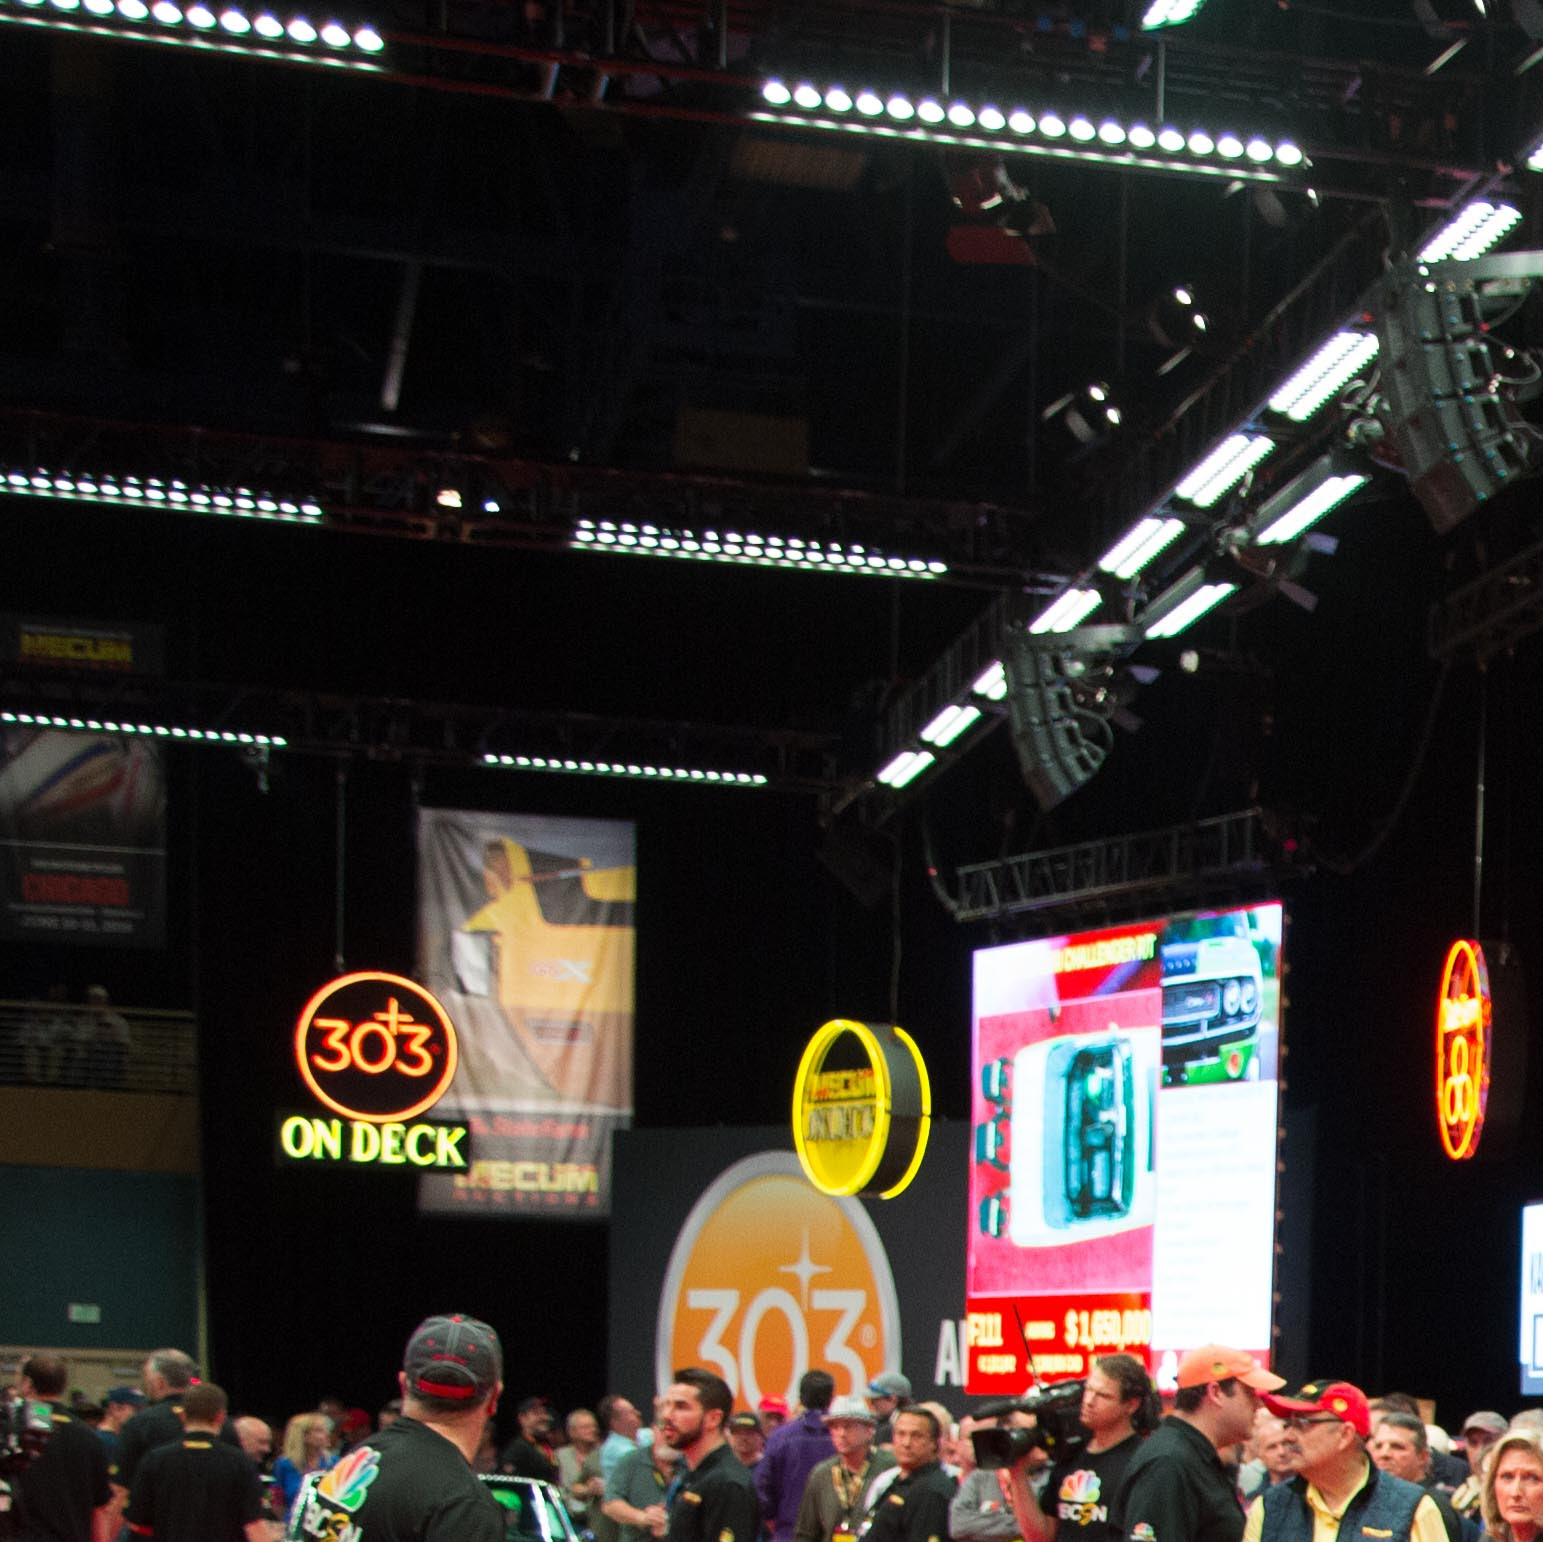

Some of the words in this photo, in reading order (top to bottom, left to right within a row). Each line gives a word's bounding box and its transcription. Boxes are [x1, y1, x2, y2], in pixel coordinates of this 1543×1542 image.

[310, 1018, 435, 1078] 303
[281, 1116, 343, 1161] ON
[350, 1120, 468, 1168] DECK
[687, 1287, 867, 1412] 303
